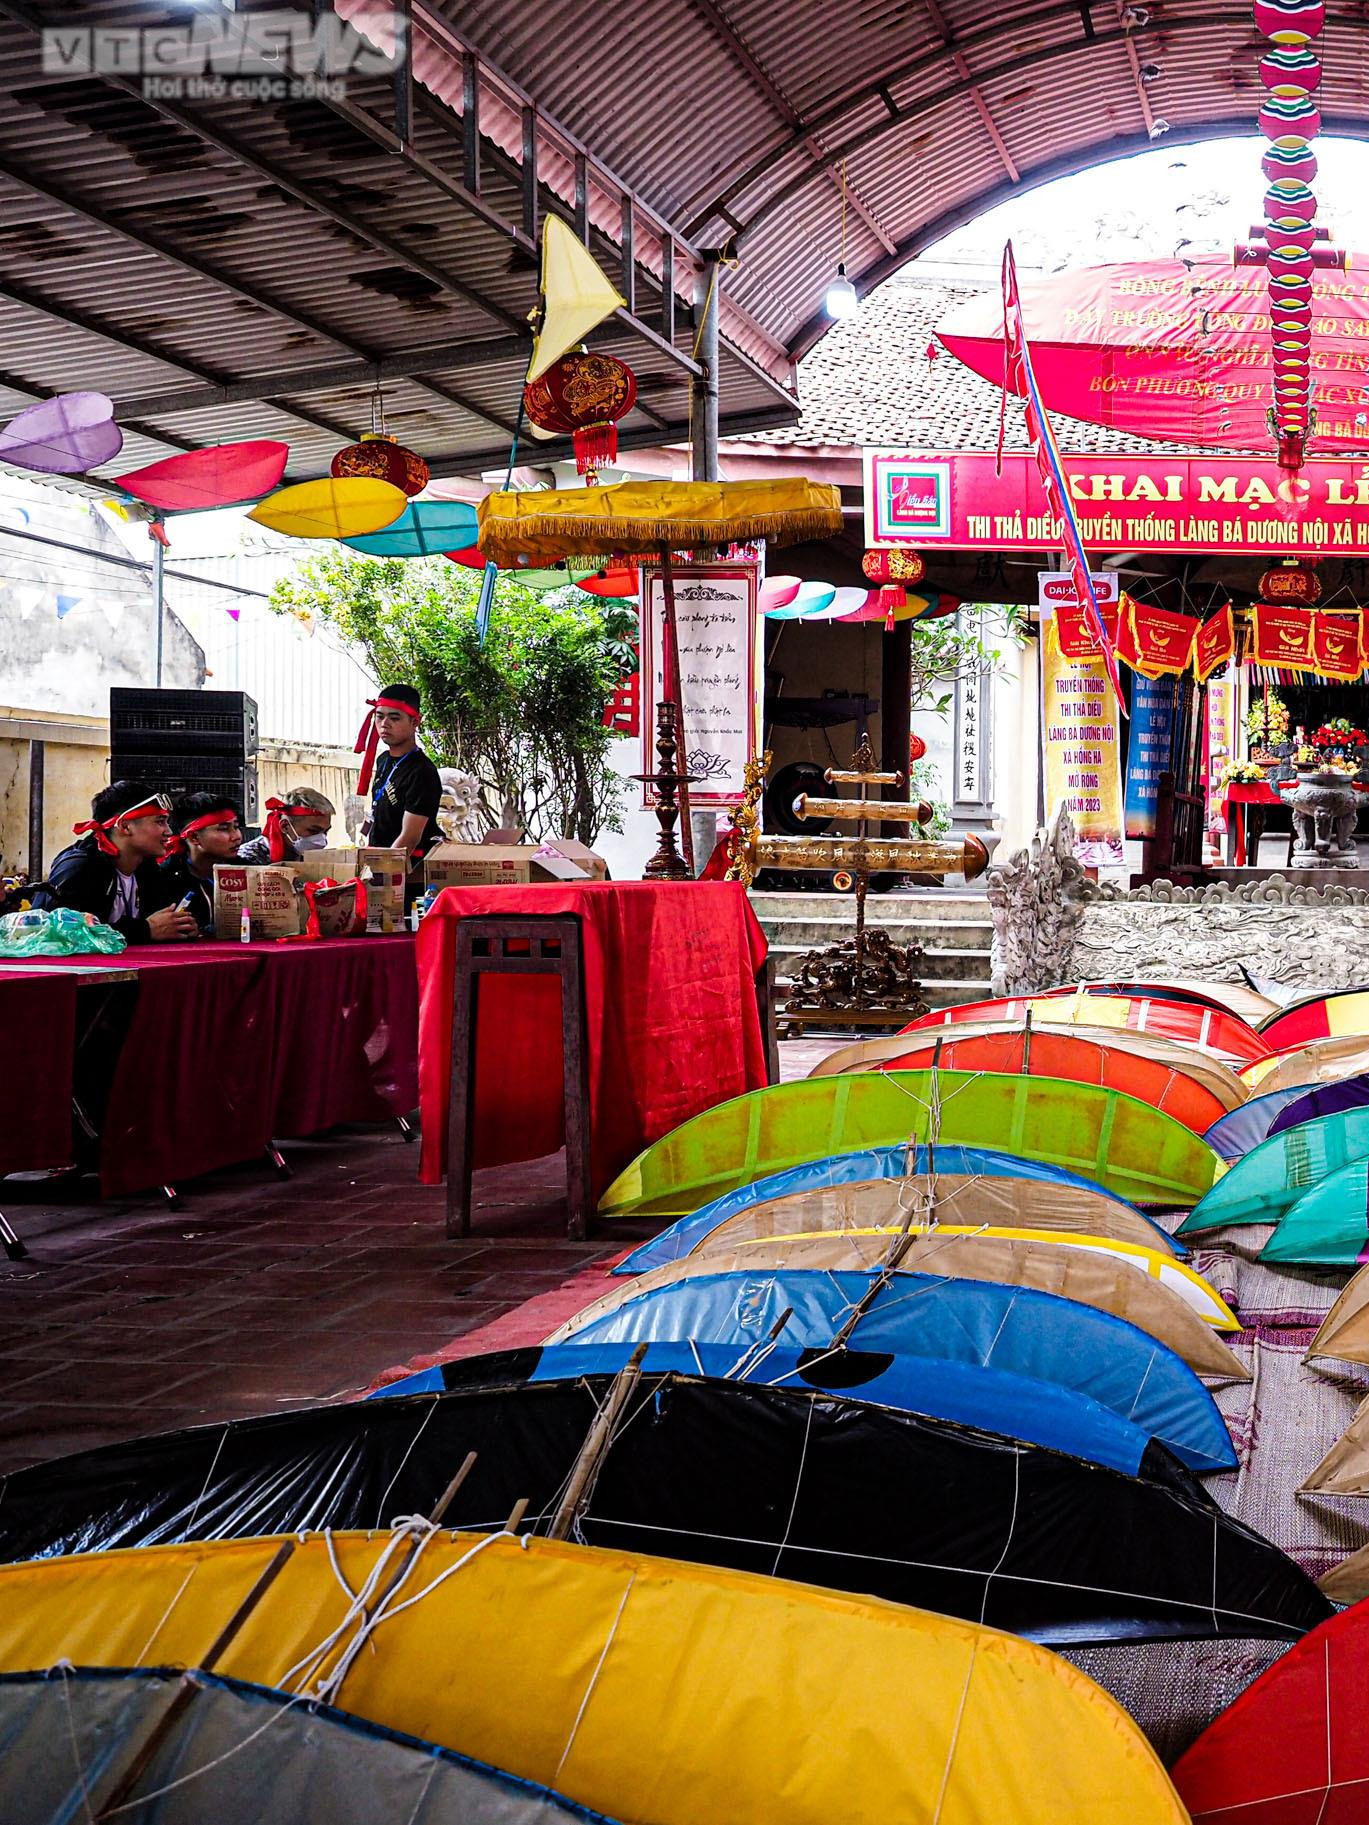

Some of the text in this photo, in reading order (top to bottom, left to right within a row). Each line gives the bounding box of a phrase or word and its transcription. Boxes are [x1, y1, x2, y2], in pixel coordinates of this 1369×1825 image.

[967, 515, 990, 539] THI
[994, 509, 1023, 540] THẢ
[1076, 511, 1122, 541] RUYỀN
[1126, 511, 1176, 542] THỐNG
[1180, 511, 1219, 542] LÀNG
[1223, 516, 1243, 543] BÁ
[1247, 519, 1298, 544] DƯƠNG
[1302, 517, 1329, 549] NỘI
[1333, 519, 1352, 545] XÃ
[220, 877, 244, 888] COSY
